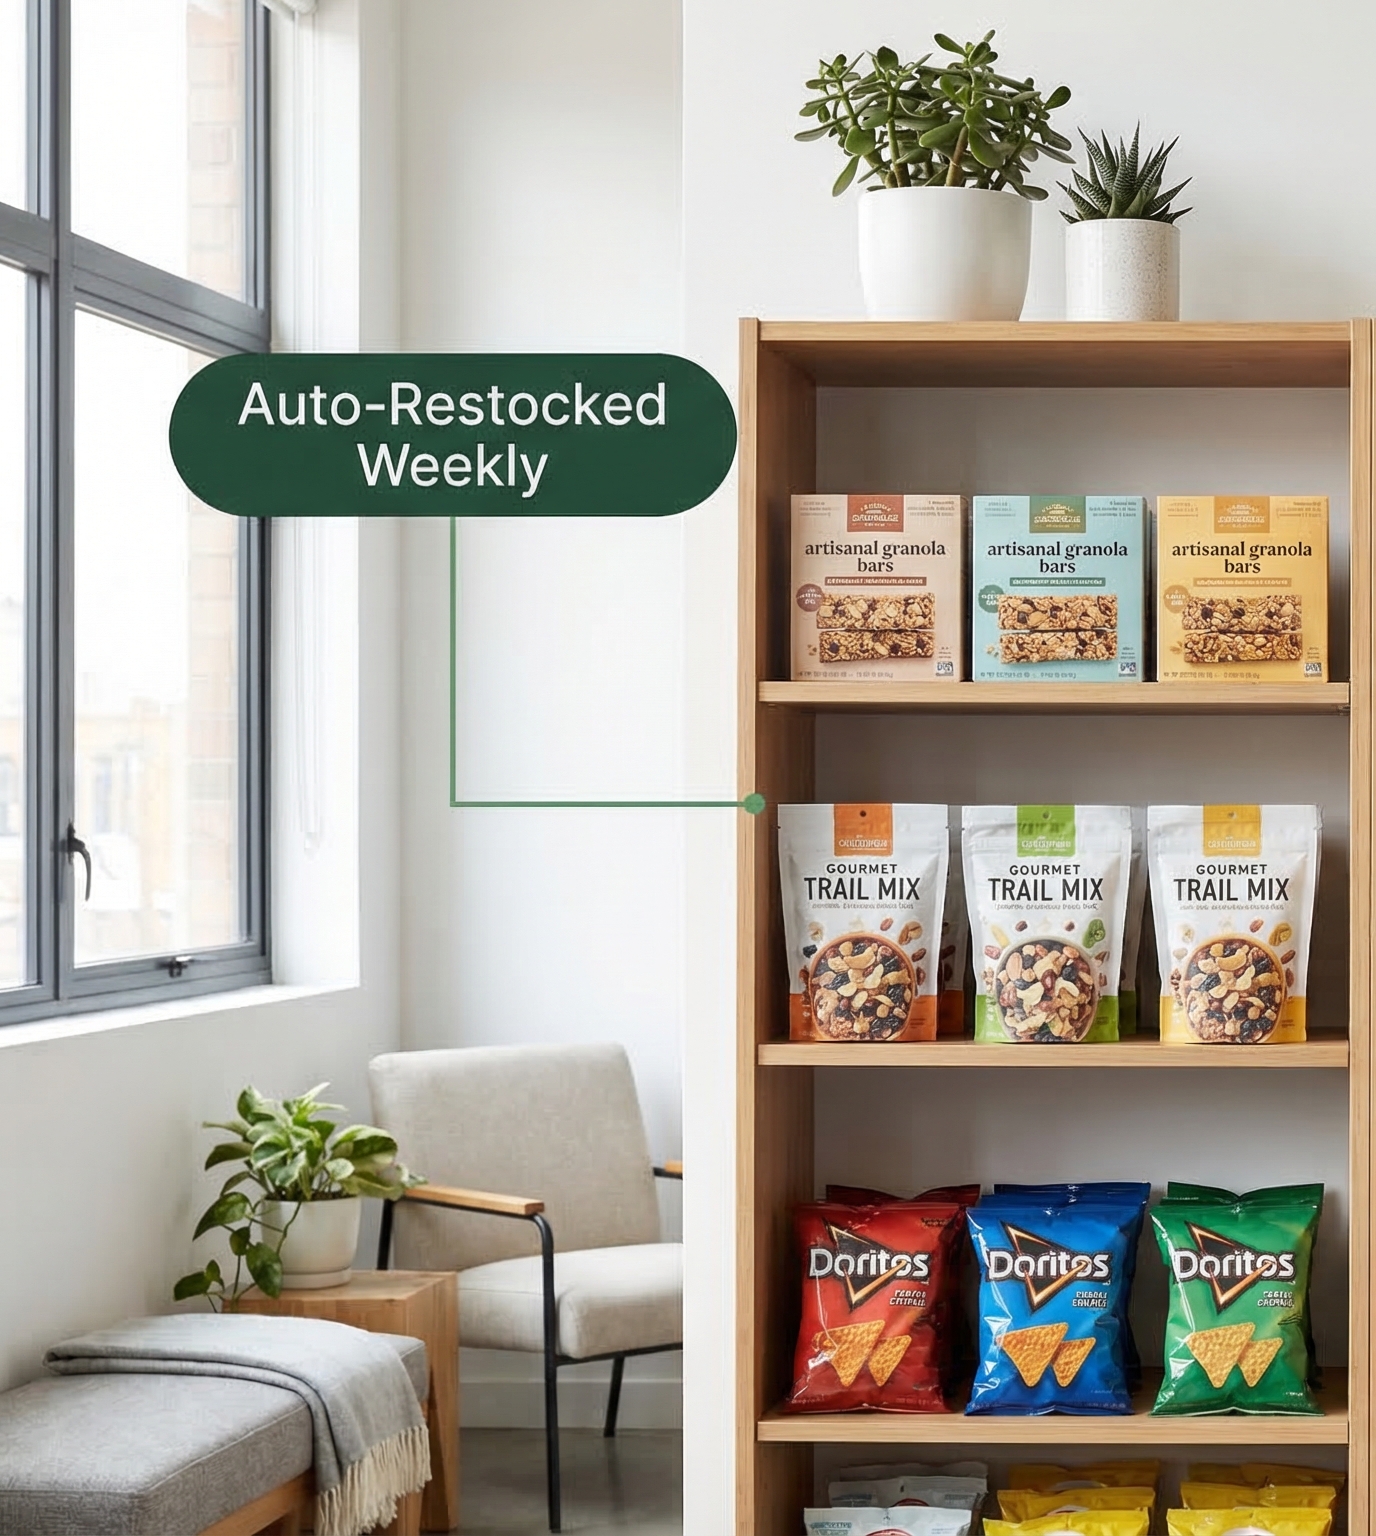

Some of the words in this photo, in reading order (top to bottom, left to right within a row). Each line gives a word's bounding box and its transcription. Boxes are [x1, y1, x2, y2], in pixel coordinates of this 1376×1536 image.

[805, 540, 878, 555] artisanal
[881, 540, 946, 560] granola
[987, 541, 1061, 556] artisanal
[1064, 541, 1128, 561] granola
[1172, 541, 1245, 556] artisanal
[1249, 541, 1312, 561] granola
[857, 556, 894, 573] bars
[1039, 558, 1076, 574] bars
[1224, 558, 1261, 574] bars
[826, 863, 898, 875] GOURMET
[1009, 864, 1081, 876] GOURMET
[1196, 864, 1268, 876] GOURMET
[803, 877, 870, 901] TRAIL
[878, 877, 921, 901] MIX
[987, 878, 1053, 902] TRAIL
[1062, 877, 1104, 901] MIX
[1173, 878, 1239, 902] TRAIL
[1247, 877, 1290, 902] MIX
[808, 1247, 930, 1278] Doritos
[988, 1249, 1110, 1280] Doritos
[1174, 1249, 1295, 1280] Doritos
